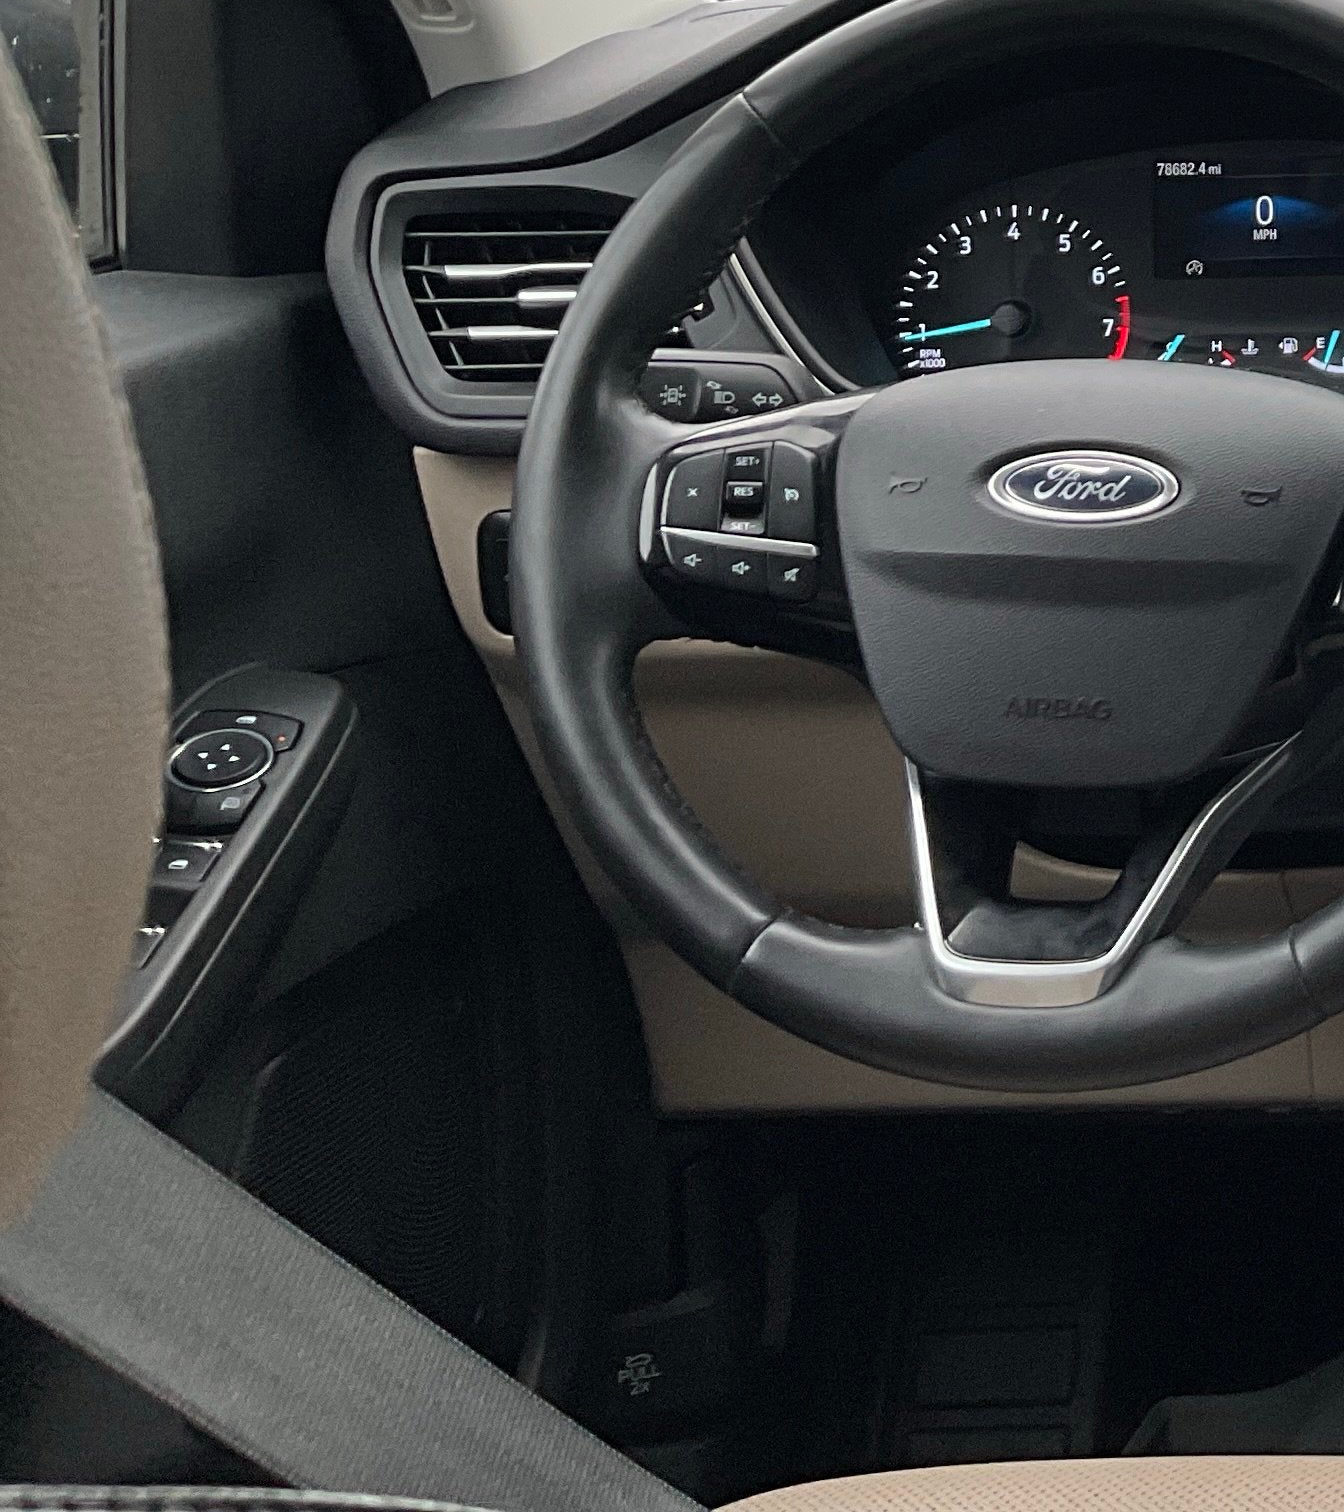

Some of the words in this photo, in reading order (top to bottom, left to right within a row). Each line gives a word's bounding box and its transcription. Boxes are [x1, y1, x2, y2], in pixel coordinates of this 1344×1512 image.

[1156, 161, 1206, 177] 78682.4
[1207, 163, 1222, 175] mi
[1256, 194, 1275, 226] 0
[1006, 223, 1021, 241] 4
[1253, 228, 1279, 241] MPH
[958, 236, 973, 256] 3
[1057, 234, 1072, 253] 5
[926, 271, 939, 290] 2
[1091, 266, 1106, 286] 6
[918, 323, 926, 341] 1
[1102, 318, 1115, 337] 7
[1211, 340, 1223, 352] H
[1315, 336, 1326, 350] E
[919, 349, 941, 359] RPM
[919, 358, 946, 368] x1000
[734, 487, 754, 497] RES
[1033, 463, 1132, 503] Ford
[1004, 696, 1112, 721] AIRBAG
